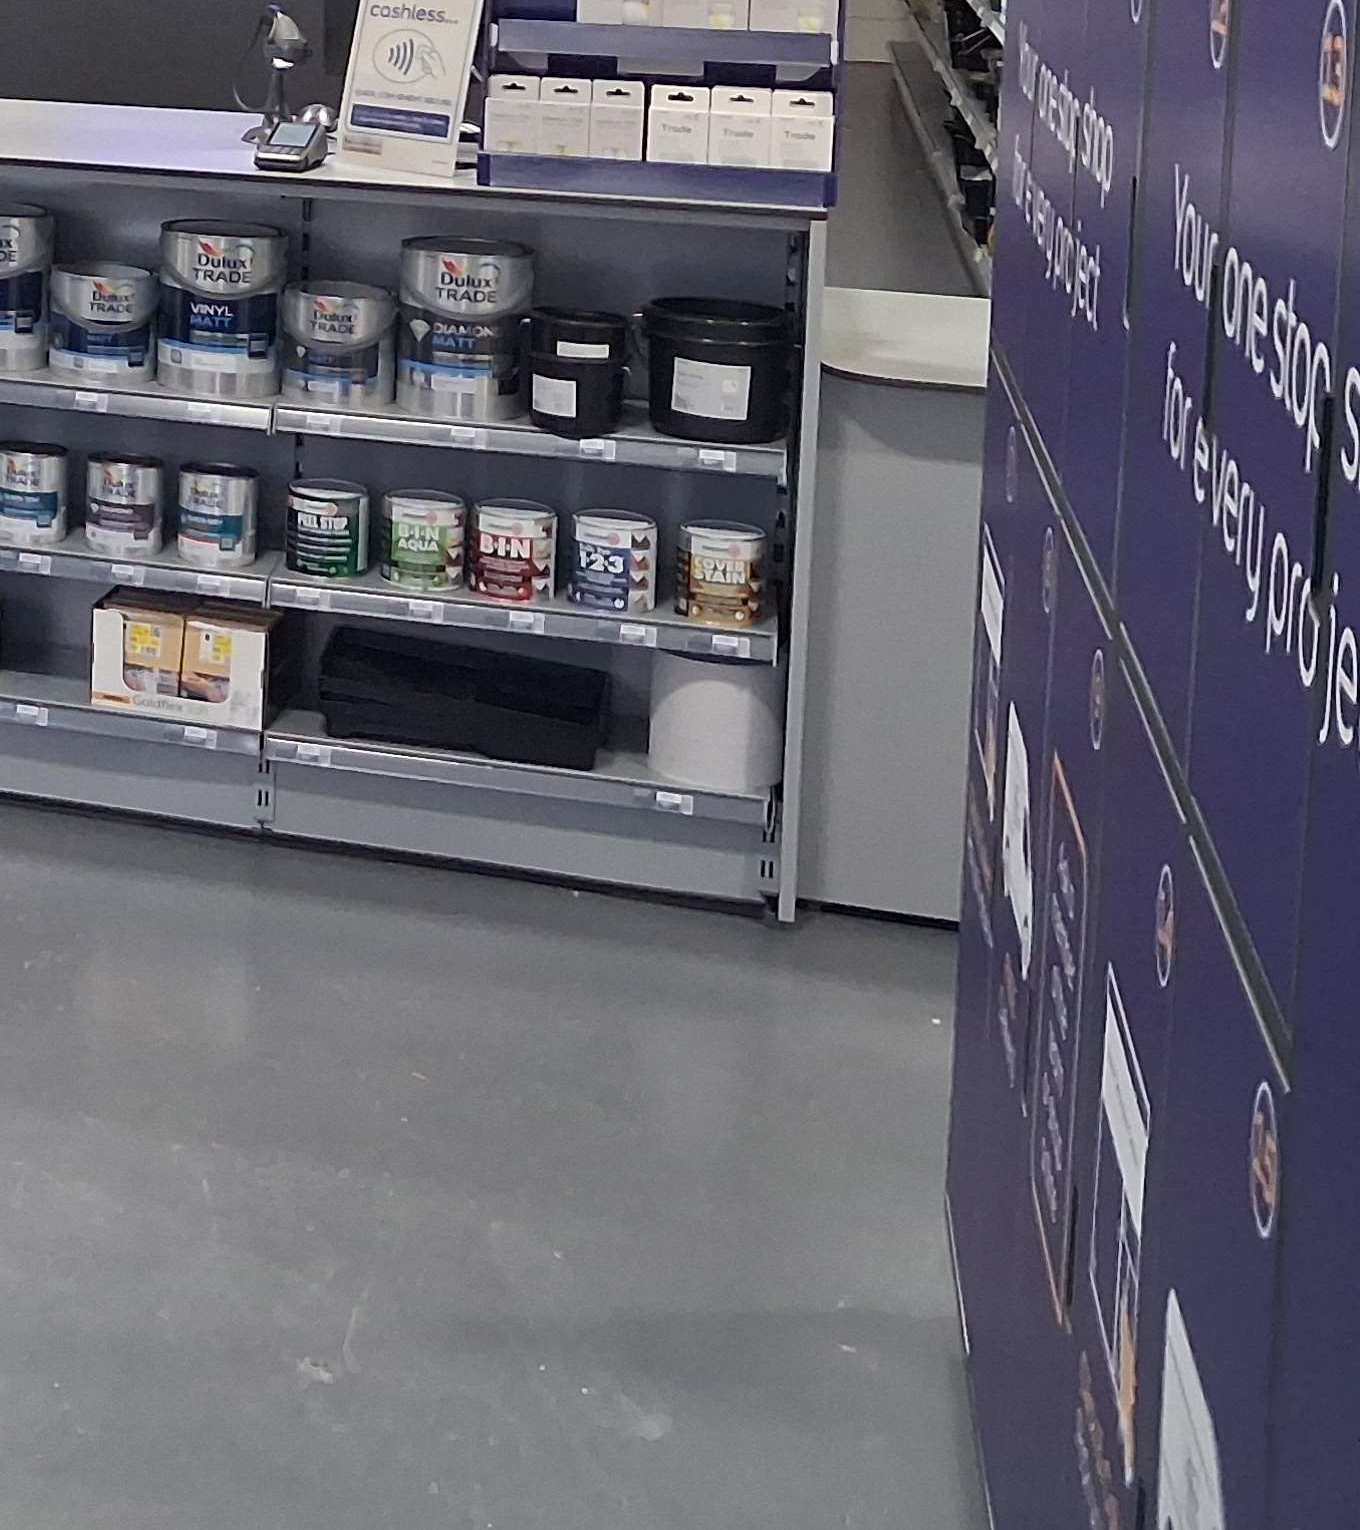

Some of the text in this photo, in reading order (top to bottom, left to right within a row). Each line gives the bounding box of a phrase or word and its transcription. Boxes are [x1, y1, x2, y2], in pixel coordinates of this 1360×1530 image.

[784, 130, 817, 142] Trade
[1081, 86, 1114, 209] shop
[197, 253, 248, 270] Dulux
[192, 267, 252, 284] TRADE
[440, 271, 493, 289] Dulux
[1053, 218, 1100, 331] project
[435, 286, 498, 304] TRADE
[189, 301, 234, 318] VINYL
[1174, 162, 1331, 474] Your one stop
[189, 314, 233, 328] MATT
[431, 334, 477, 350] MATT
[319, 516, 349, 531] STOP
[398, 538, 440, 553] AQUA
[1163, 341, 1360, 746] for every proje
[693, 555, 746, 572] COVER
[693, 568, 746, 585] STAIN
